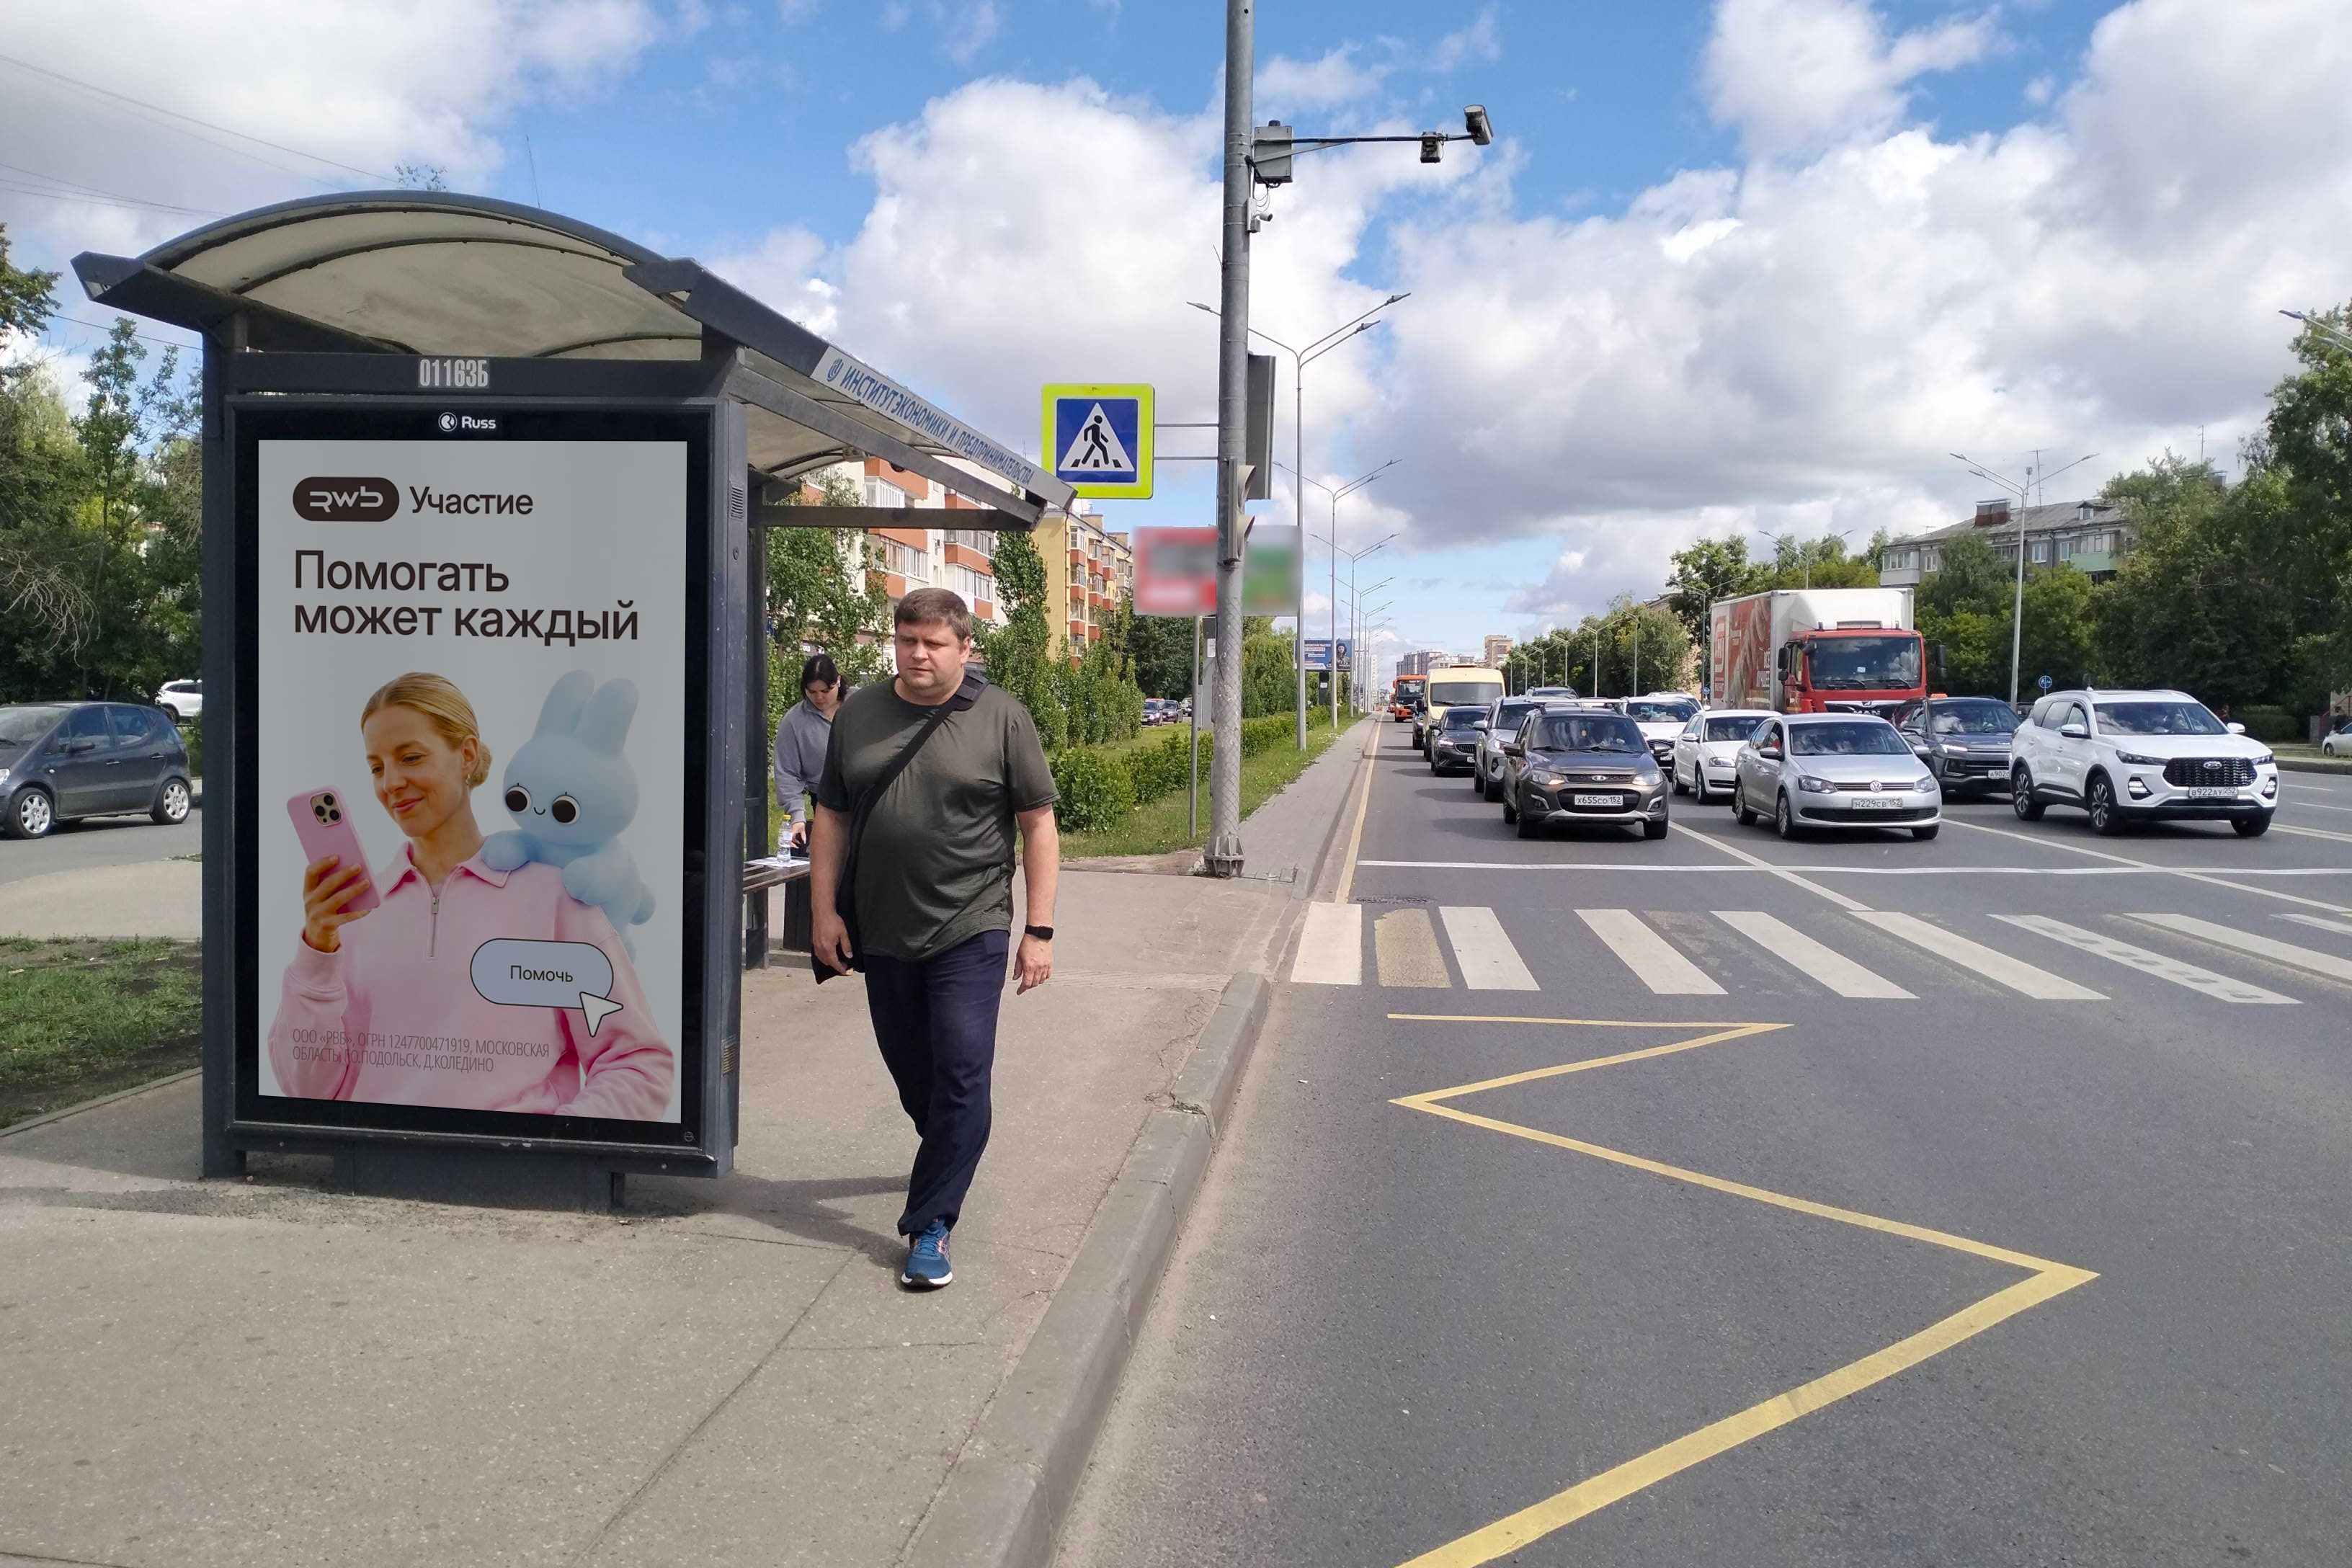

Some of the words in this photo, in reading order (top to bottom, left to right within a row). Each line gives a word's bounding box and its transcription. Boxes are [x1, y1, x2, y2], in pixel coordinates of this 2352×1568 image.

[839, 365, 899, 411] ИНСТИТУТ
[891, 393, 951, 440] ЭКОНОМИКИ
[946, 426, 959, 445] И
[461, 416, 496, 429] Russ
[409, 486, 533, 514] Участие
[295, 550, 509, 592] Помогать
[295, 605, 442, 635] может
[455, 600, 638, 647] каждый
[510, 965, 574, 982] Помочь
[293, 1028, 317, 1043] ООО
[319, 1030, 355, 1048] «РВБ»,
[358, 1033, 386, 1048] ОГРН
[388, 1034, 473, 1055] 1247700471919,
[476, 1039, 550, 1058] МОСКОВСКАЯ
[423, 1054, 494, 1072] Д.КОЛЕДИНО
